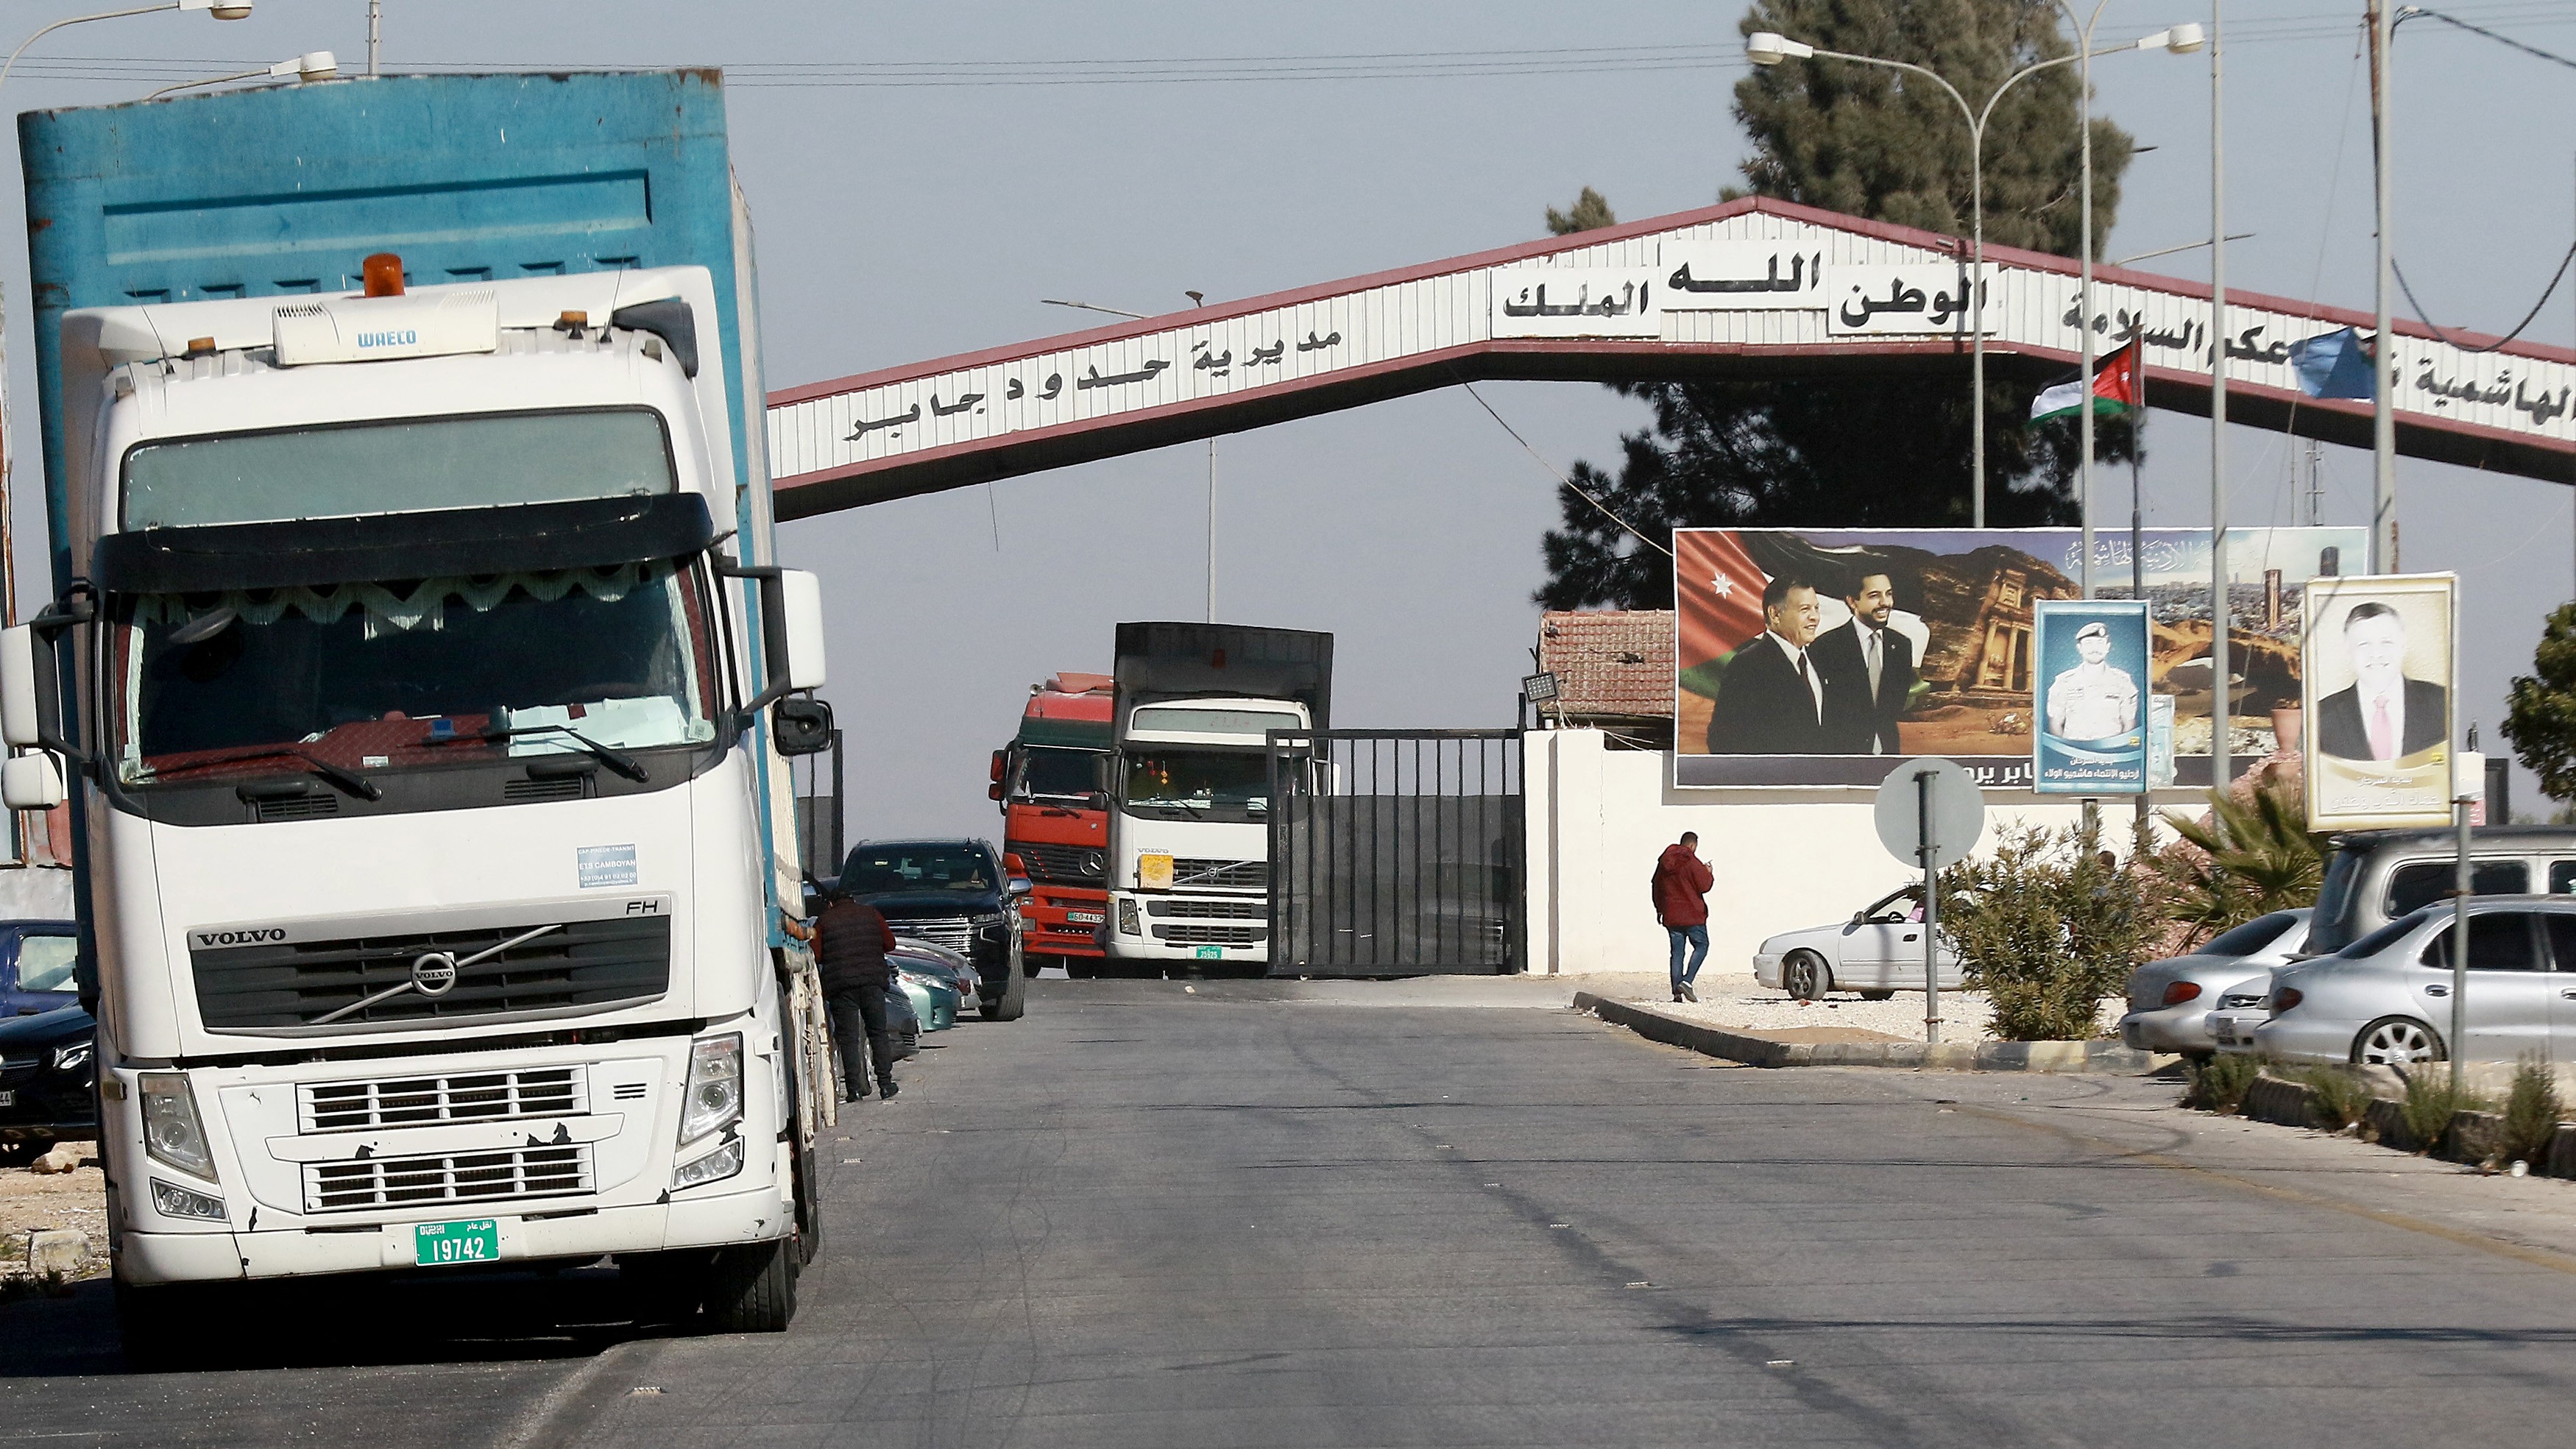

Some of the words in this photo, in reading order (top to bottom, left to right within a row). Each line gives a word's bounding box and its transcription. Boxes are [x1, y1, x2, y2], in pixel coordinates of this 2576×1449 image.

[1668, 251, 1822, 292] الله
[1502, 278, 1649, 319] الملك
[1841, 277, 1987, 327] الوطن
[358, 330, 417, 347] WAECO
[1191, 329, 1342, 378] مديرية
[1006, 358, 1171, 400] حدود
[2416, 356, 2576, 425] لهاشمية
[843, 391, 986, 442] جابر
[2000, 762, 2033, 784] ابر
[595, 860, 635, 868] CAMBOYAN
[626, 900, 658, 915] FH
[197, 928, 286, 946] VOLVO
[416, 971, 453, 979] VOLVO
[433, 1237, 485, 1261] 19742
